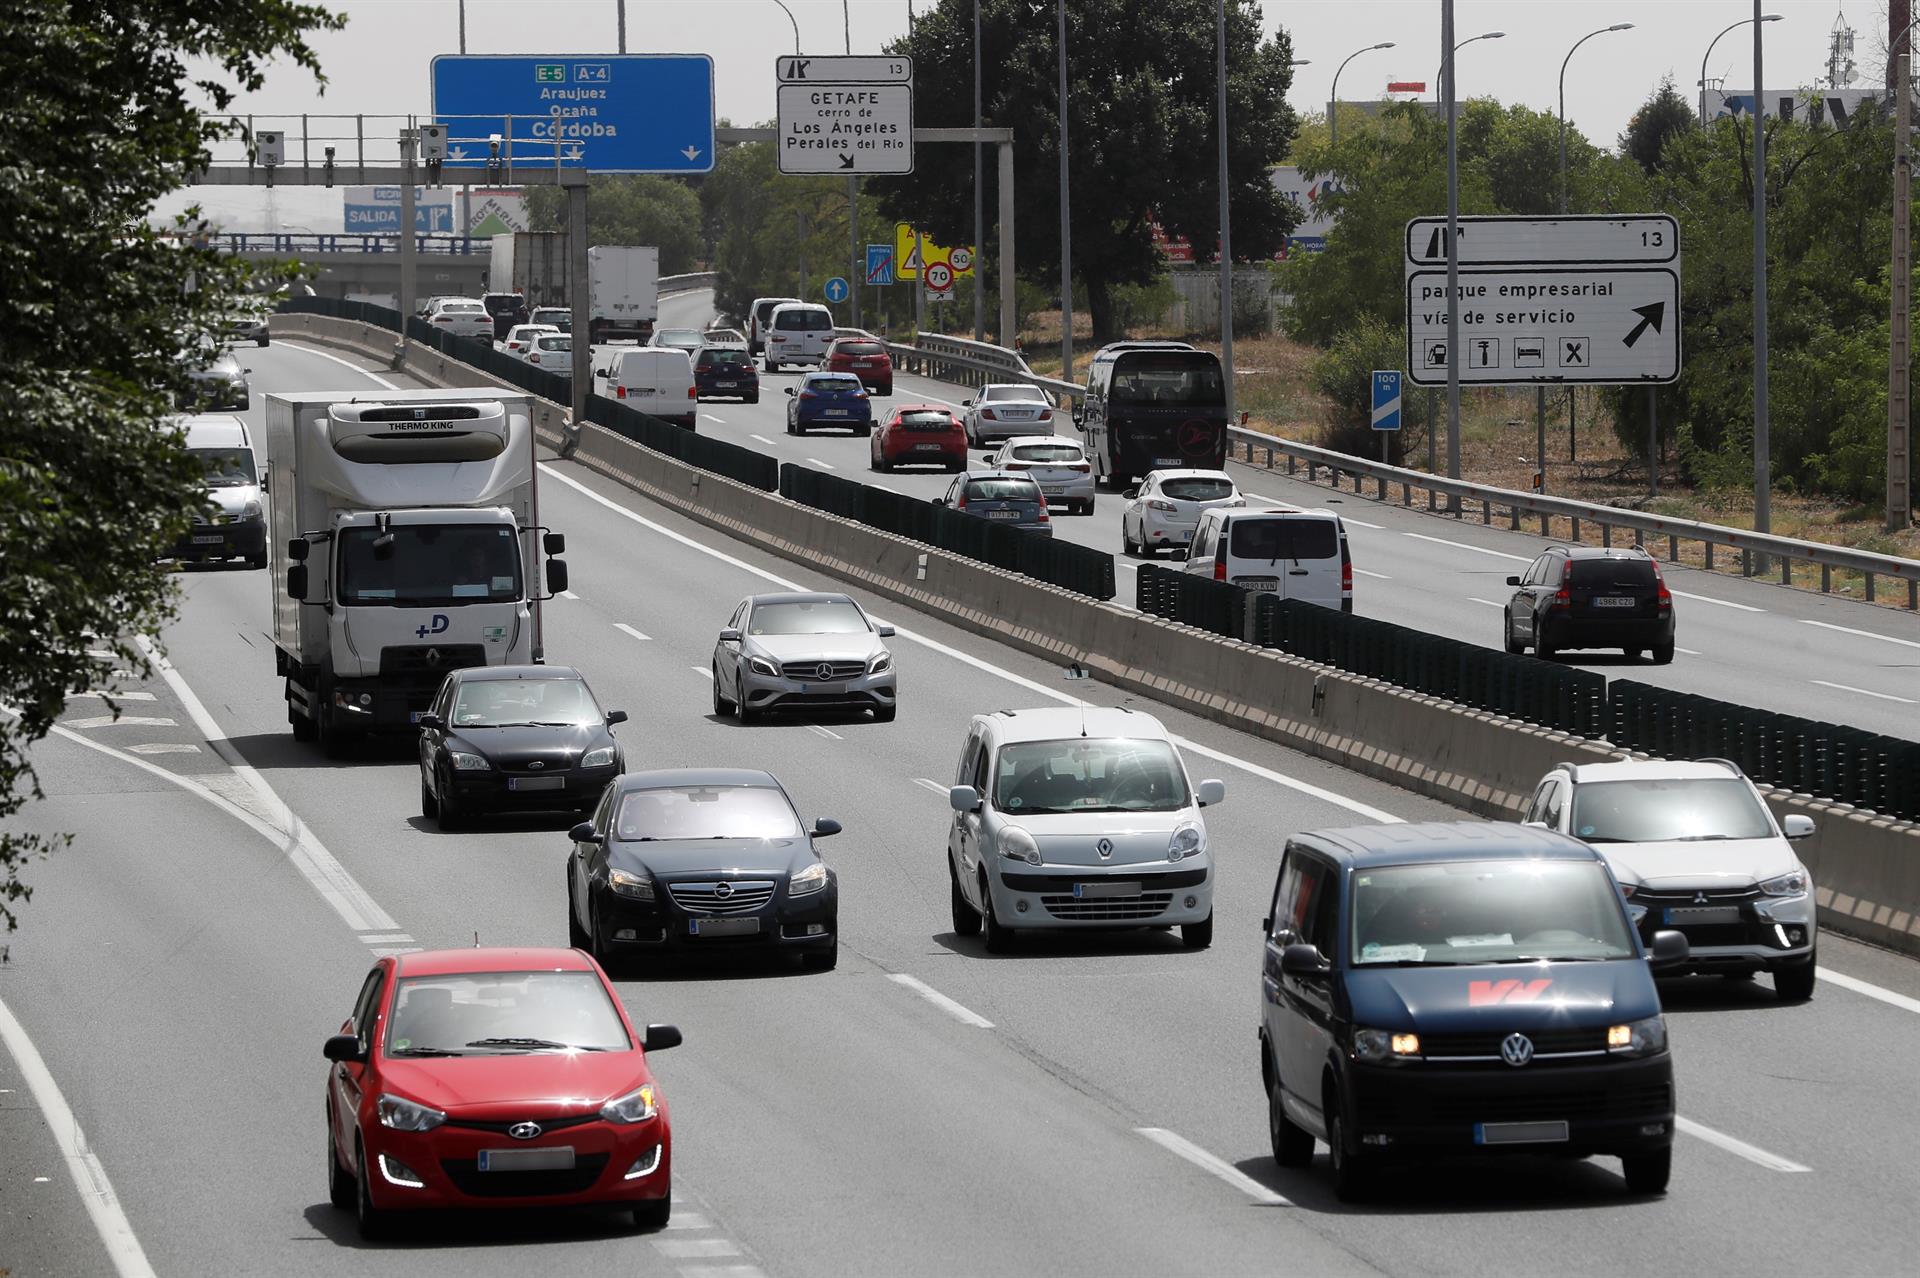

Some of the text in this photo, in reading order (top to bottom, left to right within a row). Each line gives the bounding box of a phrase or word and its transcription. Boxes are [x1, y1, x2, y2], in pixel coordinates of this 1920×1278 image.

[538, 67, 563, 80] E-5
[578, 67, 606, 80] A-4
[889, 65, 903, 74] 13
[811, 93, 879, 105] GETAFE
[550, 105, 597, 117] Ocaña
[818, 108, 872, 117] cerro de
[532, 121, 616, 137] Córdoba
[793, 119, 897, 136] Los Ángeles
[787, 137, 904, 149] Perales del Río
[350, 210, 397, 222] SALIDA
[1641, 232, 1663, 247] 13
[953, 255, 967, 263] 50
[932, 271, 948, 281] 70
[1499, 282, 1613, 299] empresarial
[1463, 310, 1485, 324] de
[1496, 310, 1575, 324] servicio
[1378, 375, 1396, 383] 100
[389, 421, 454, 431] THERMO KING
